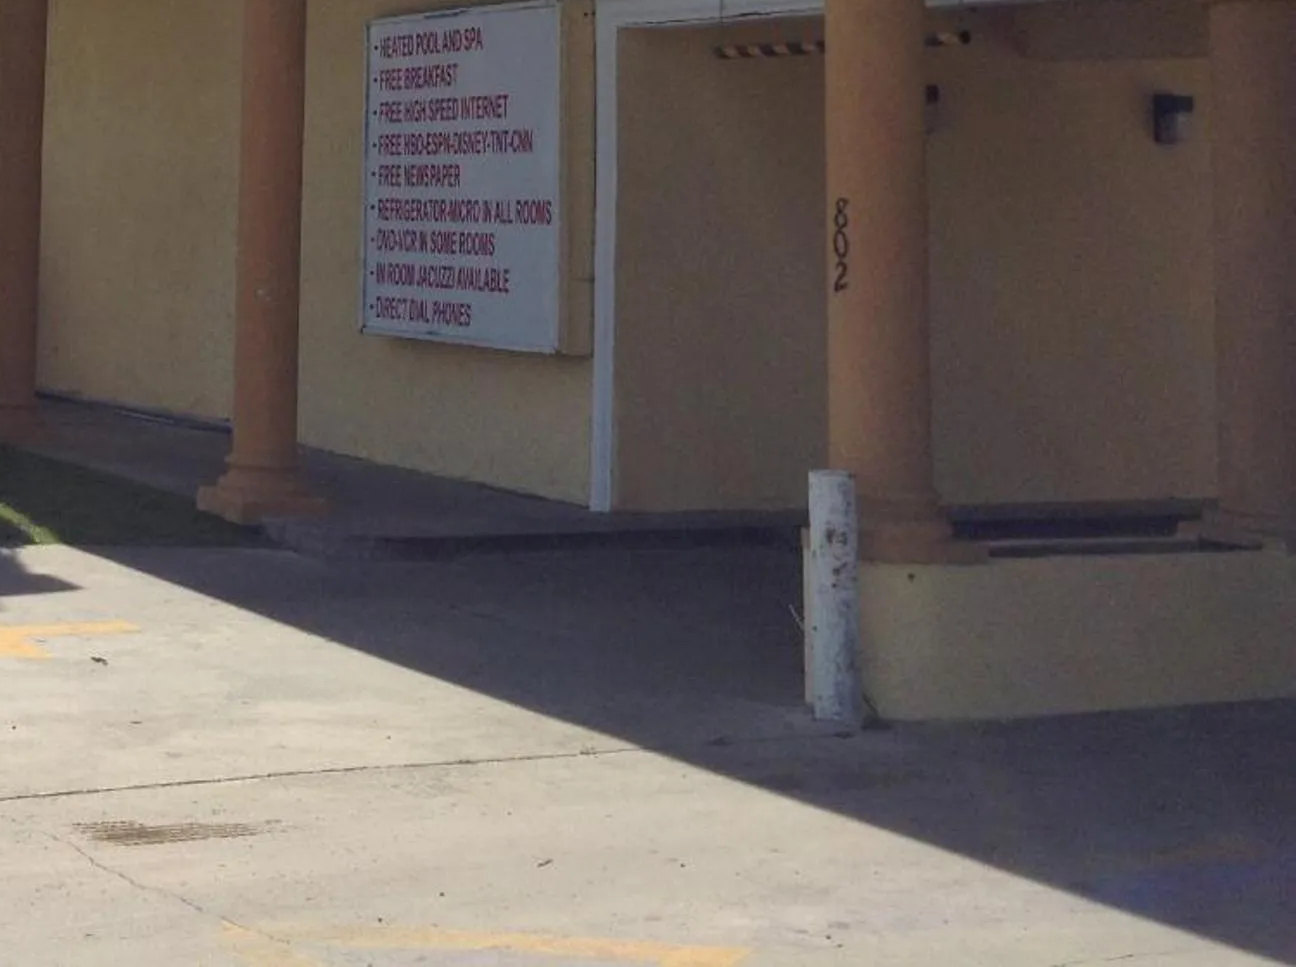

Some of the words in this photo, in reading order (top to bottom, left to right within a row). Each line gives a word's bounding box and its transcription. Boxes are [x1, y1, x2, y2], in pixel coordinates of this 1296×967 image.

[379, 34, 414, 58] HEATED
[415, 32, 442, 56] POOL
[442, 29, 463, 53] AND
[463, 26, 484, 52] SPA
[379, 68, 402, 90] FREE
[404, 63, 458, 90] BREAKFAST
[379, 100, 402, 123] FREE
[404, 99, 426, 123] HIGH
[428, 97, 459, 122] SPEED
[461, 94, 510, 120] INTERNET
[378, 133, 402, 155] FREE
[378, 164, 402, 187] FREE
[404, 164, 460, 188] NEWSPAPER
[483, 199, 493, 223] IN
[493, 199, 513, 224] ALL
[516, 199, 552, 225] ROOMS
[419, 230, 428, 253] IN
[430, 231, 455, 254] SOME
[458, 232, 495, 256] ROOMS
[833, 197, 849, 292] 802
[376, 262, 387, 284] IN
[388, 263, 415, 285] ROOM
[416, 264, 455, 289] JACUZZI
[455, 267, 510, 293] AVAILABLE
[375, 296, 406, 319] DIRECT
[409, 297, 430, 323] DIAL
[432, 301, 472, 327] PHONES
